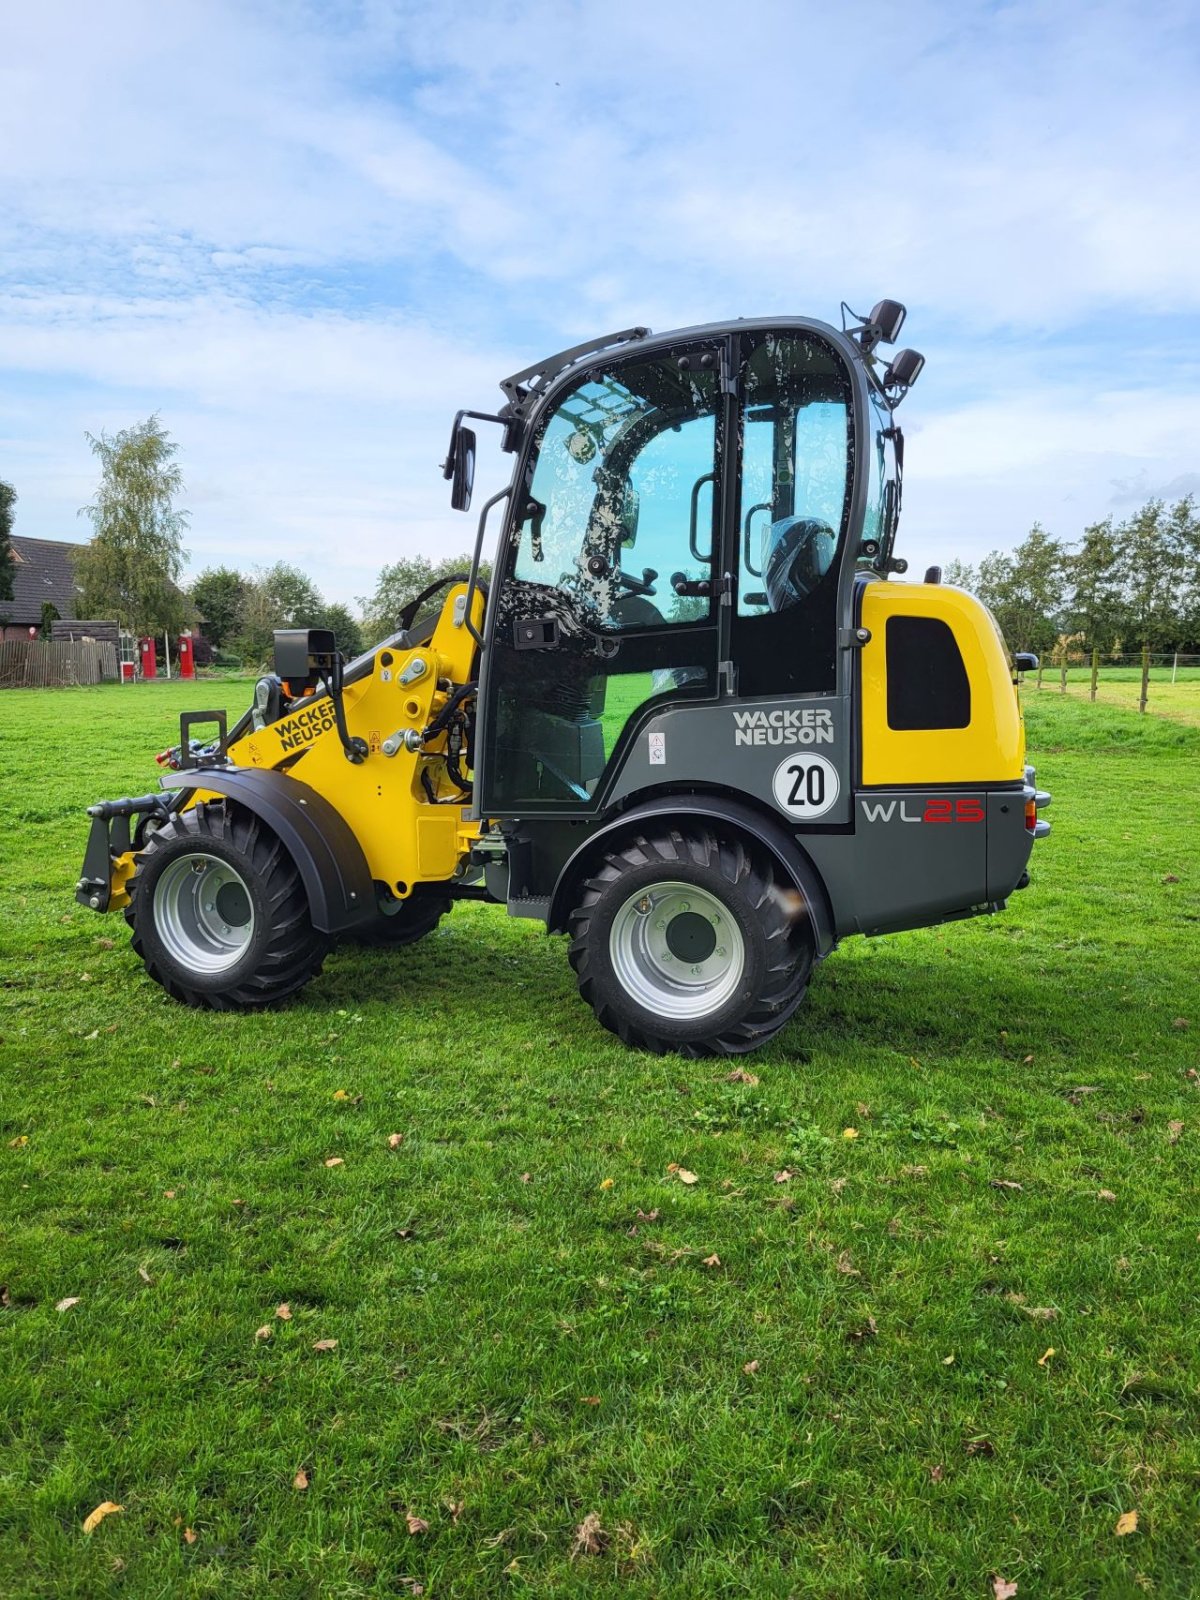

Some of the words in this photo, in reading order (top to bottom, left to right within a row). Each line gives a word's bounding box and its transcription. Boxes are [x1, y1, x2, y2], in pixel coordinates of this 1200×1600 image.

[732, 708, 834, 728] WACKER
[734, 726, 834, 746] NEUSON
[786, 764, 825, 807] 20
[861, 799, 985, 823] WL25
